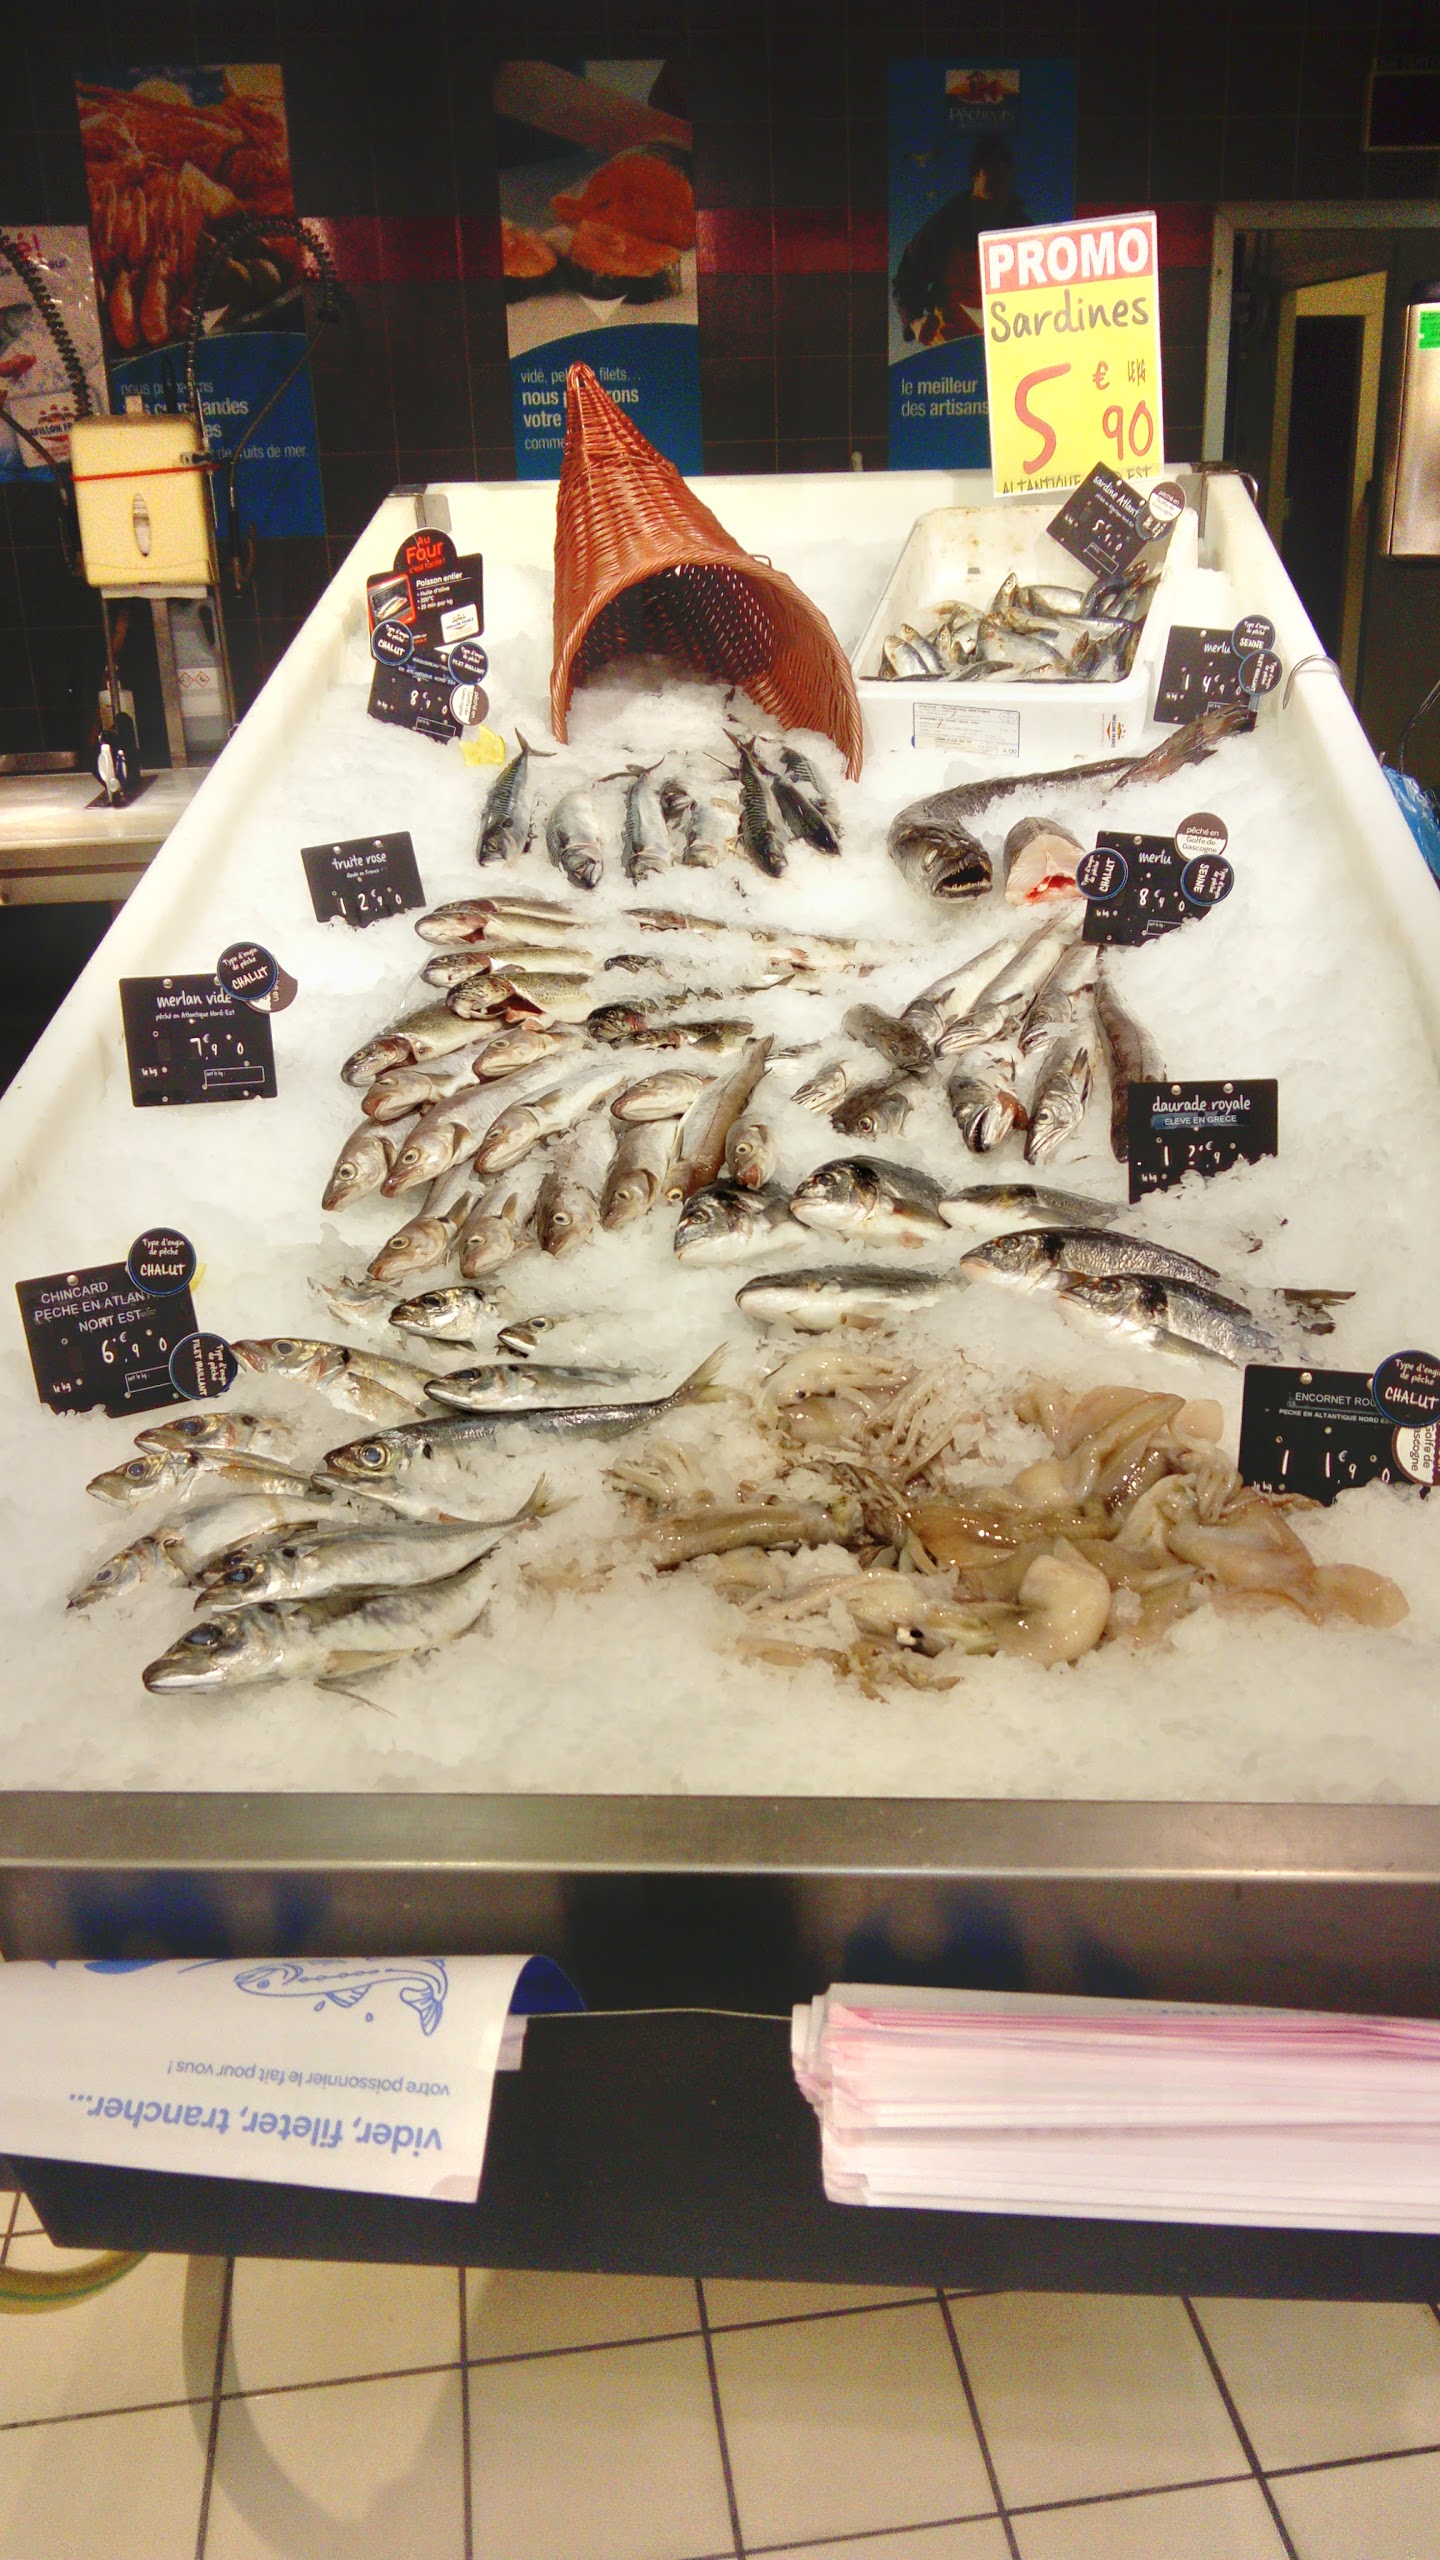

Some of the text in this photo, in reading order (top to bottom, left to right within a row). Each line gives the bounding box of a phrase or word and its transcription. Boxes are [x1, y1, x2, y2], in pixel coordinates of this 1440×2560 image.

[988, 227, 1149, 289] PROMO
[990, 288, 1149, 343] Sardines
[1092, 360, 1110, 391] €
[901, 376, 978, 396] le meilleur
[522, 391, 559, 406] nous
[901, 400, 926, 417] des
[523, 410, 562, 428] votre
[1014, 362, 1072, 475] 5
[1102, 400, 1154, 461] 90
[405, 542, 444, 565] Four
[416, 571, 463, 588] Poisson entier
[377, 638, 406, 656] CHALUT
[1204, 640, 1231, 655] merlu
[1239, 637, 1264, 649] SENNE
[1186, 825, 1210, 837] pêché
[1182, 843, 1218, 854] Gascogne
[1186, 836, 1216, 846] Golfe de
[331, 853, 388, 871] truite rose
[1138, 849, 1172, 866] merlu
[1098, 857, 1116, 893] CHALUT
[1193, 863, 1210, 893] SENNE
[232, 965, 269, 990] CHALUT
[156, 989, 203, 1009] merlan
[1152, 1094, 1251, 1116] daurade royale
[1164, 1115, 1238, 1126] ELEVE EN GRECE
[140, 1263, 187, 1277] CHALUT
[40, 1281, 109, 1304] CHINCARD
[34, 1303, 80, 1322] PECHE
[82, 1300, 101, 1313] EN
[78, 1309, 142, 1333] NORT EST
[1395, 1358, 1440, 1379] Type d'engi
[61, 1381, 72, 1393] kg
[1295, 1392, 1376, 1408] ENCORNET ROU
[1385, 1386, 1440, 1410] CHALUT
[1278, 1408, 1301, 1416] PECHE
[1313, 1411, 1357, 1422] ALTANTIQUE
[1358, 1416, 1379, 1424] NORD
[1410, 1427, 1421, 1471] ascogne
[1423, 1454, 1433, 1469] de
[175, 2060, 214, 2075] vous
[214, 2063, 257, 2079] pour
[259, 2066, 286, 2086] fait
[288, 2070, 303, 2088] le
[309, 2071, 404, 2095] poissonnier
[406, 2082, 450, 2097] votre
[239, 2105, 343, 2149] fileter,
[352, 2115, 443, 2158] vider,
